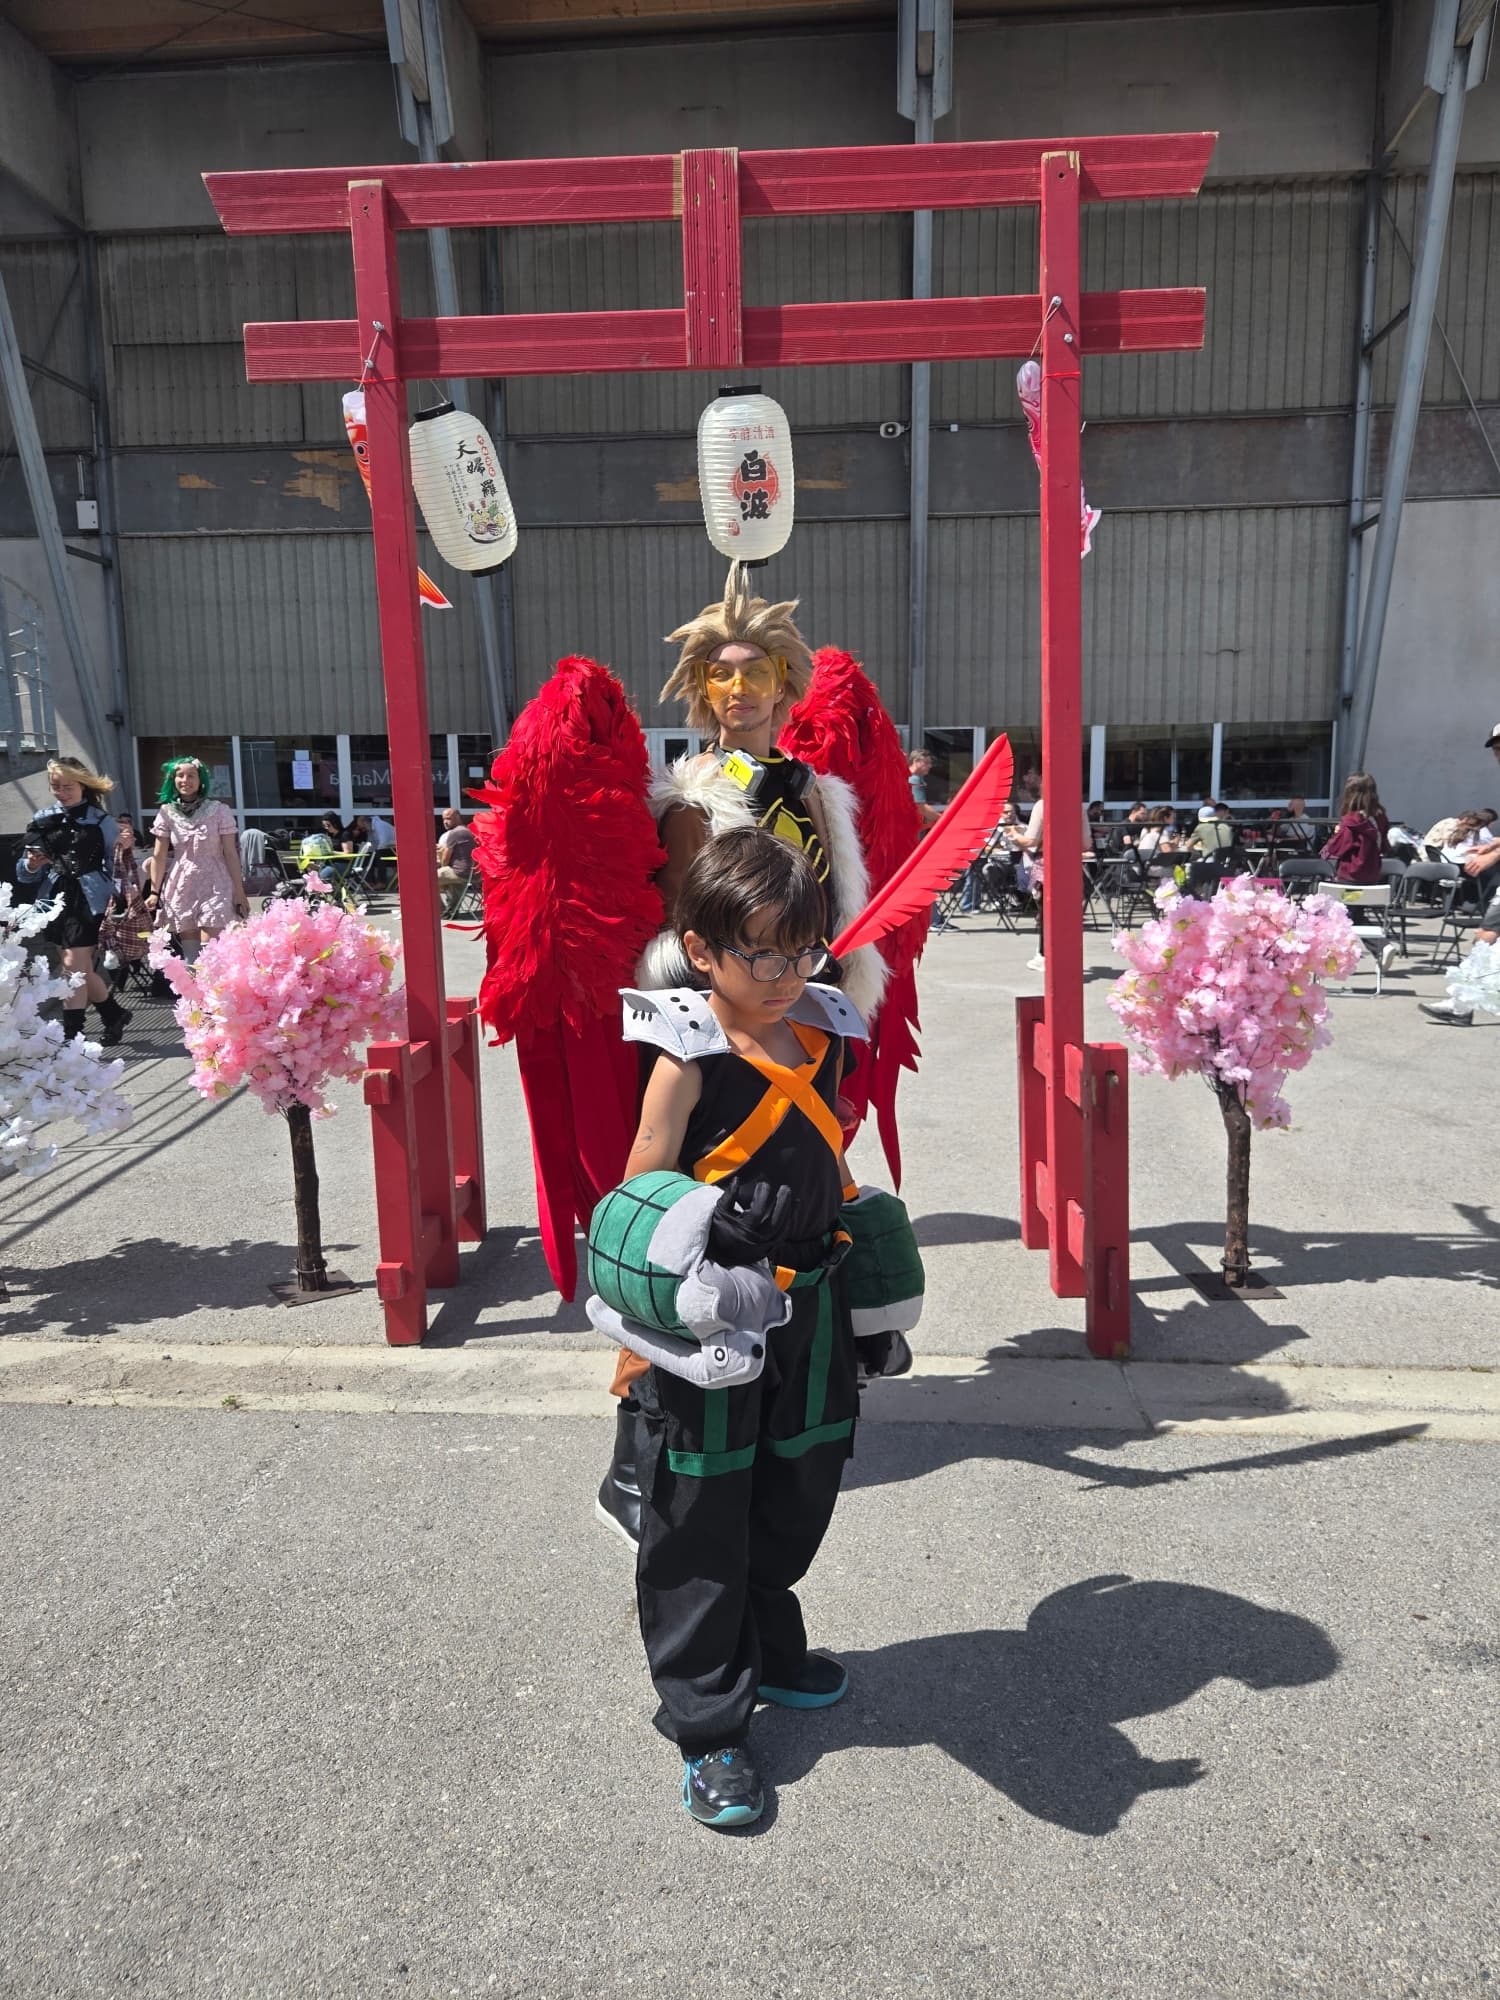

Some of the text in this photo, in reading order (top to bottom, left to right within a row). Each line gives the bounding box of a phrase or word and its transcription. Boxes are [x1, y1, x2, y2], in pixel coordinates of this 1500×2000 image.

[456, 439, 499, 498] 天婦羅
[740, 449, 771, 521] 白波
